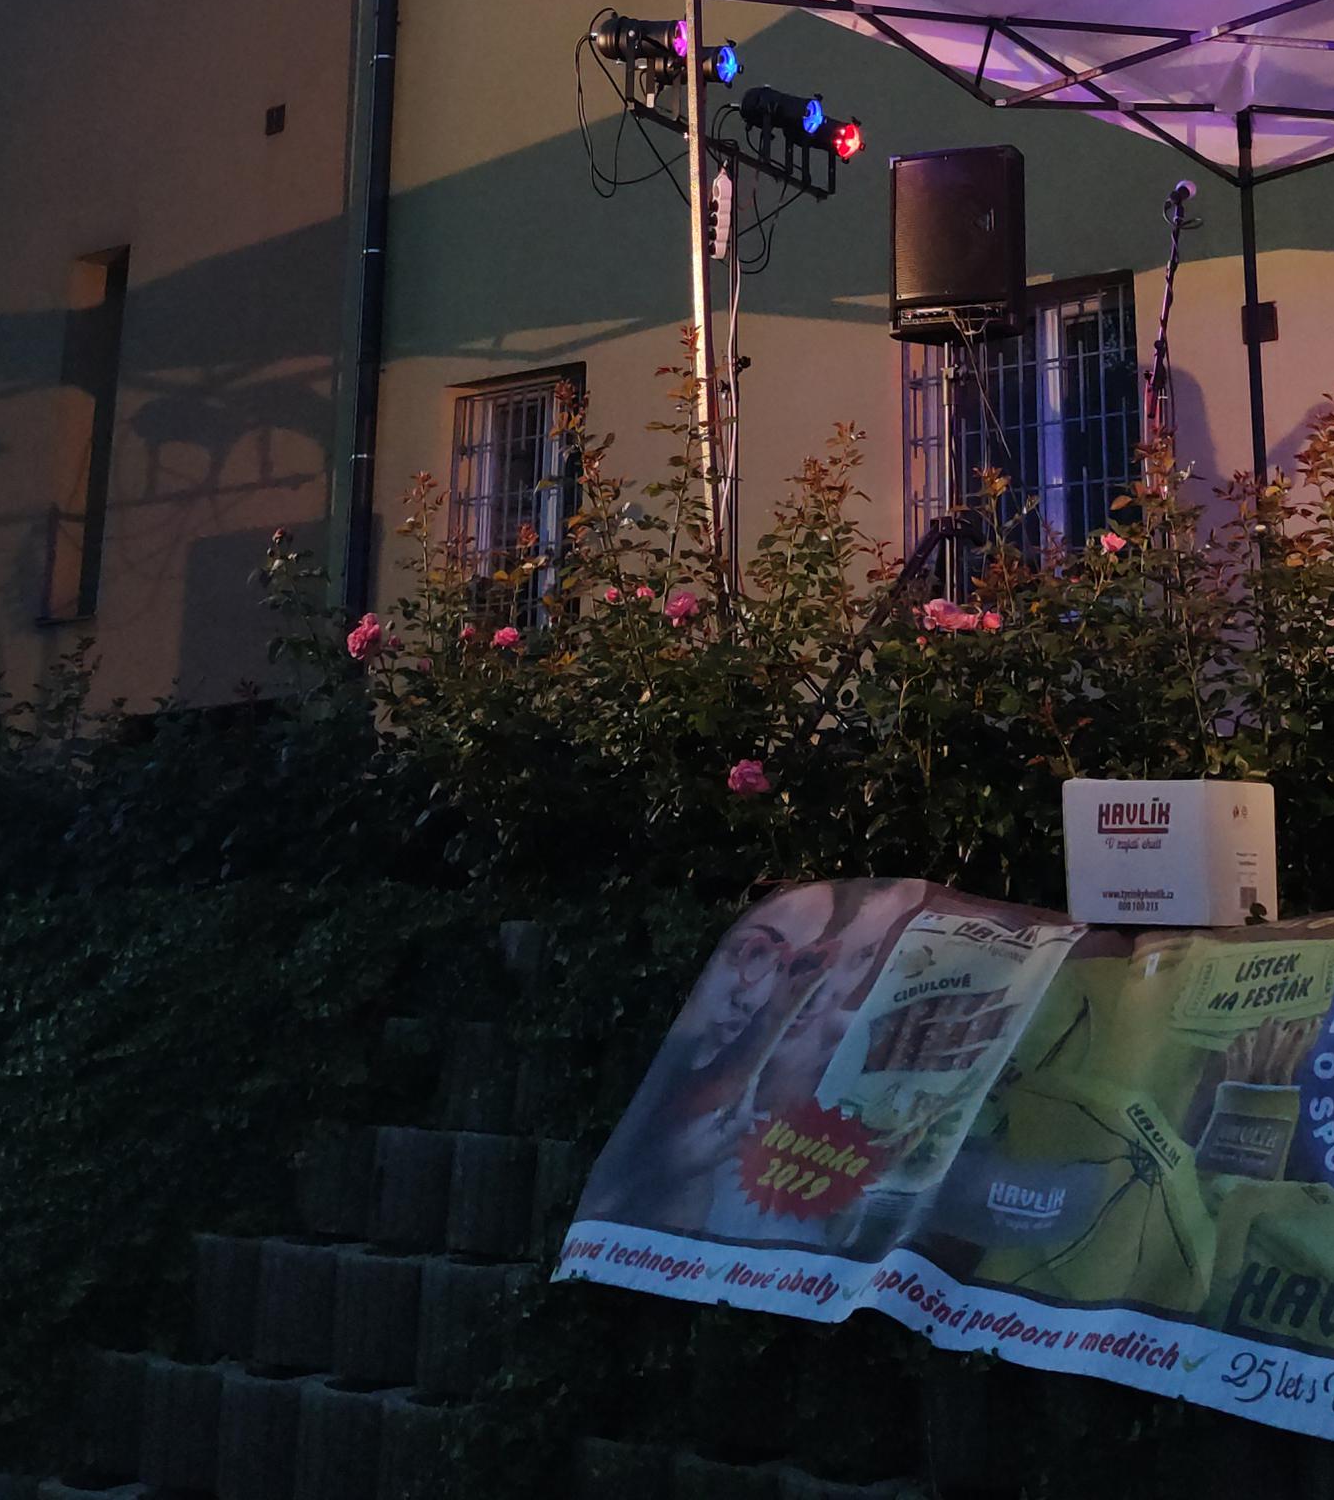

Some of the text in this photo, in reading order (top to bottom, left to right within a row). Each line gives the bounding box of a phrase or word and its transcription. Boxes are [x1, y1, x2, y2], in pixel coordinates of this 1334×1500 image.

[1098, 797, 1171, 833] HAVLÍK
[1234, 952, 1301, 983] LÍSTEK
[893, 972, 972, 1004] CIBULOVÉ
[1207, 991, 1239, 1011] NA
[761, 1118, 870, 1179] Novinka
[756, 1157, 832, 1201] 2019
[724, 1261, 777, 1289] Nové
[777, 1273, 840, 1305] obaly
[871, 1267, 969, 1328] oplošná
[961, 1308, 1063, 1350] podpora
[1063, 1331, 1078, 1350] v
[1221, 1351, 1277, 1403] 25
[1274, 1361, 1304, 1401] let
